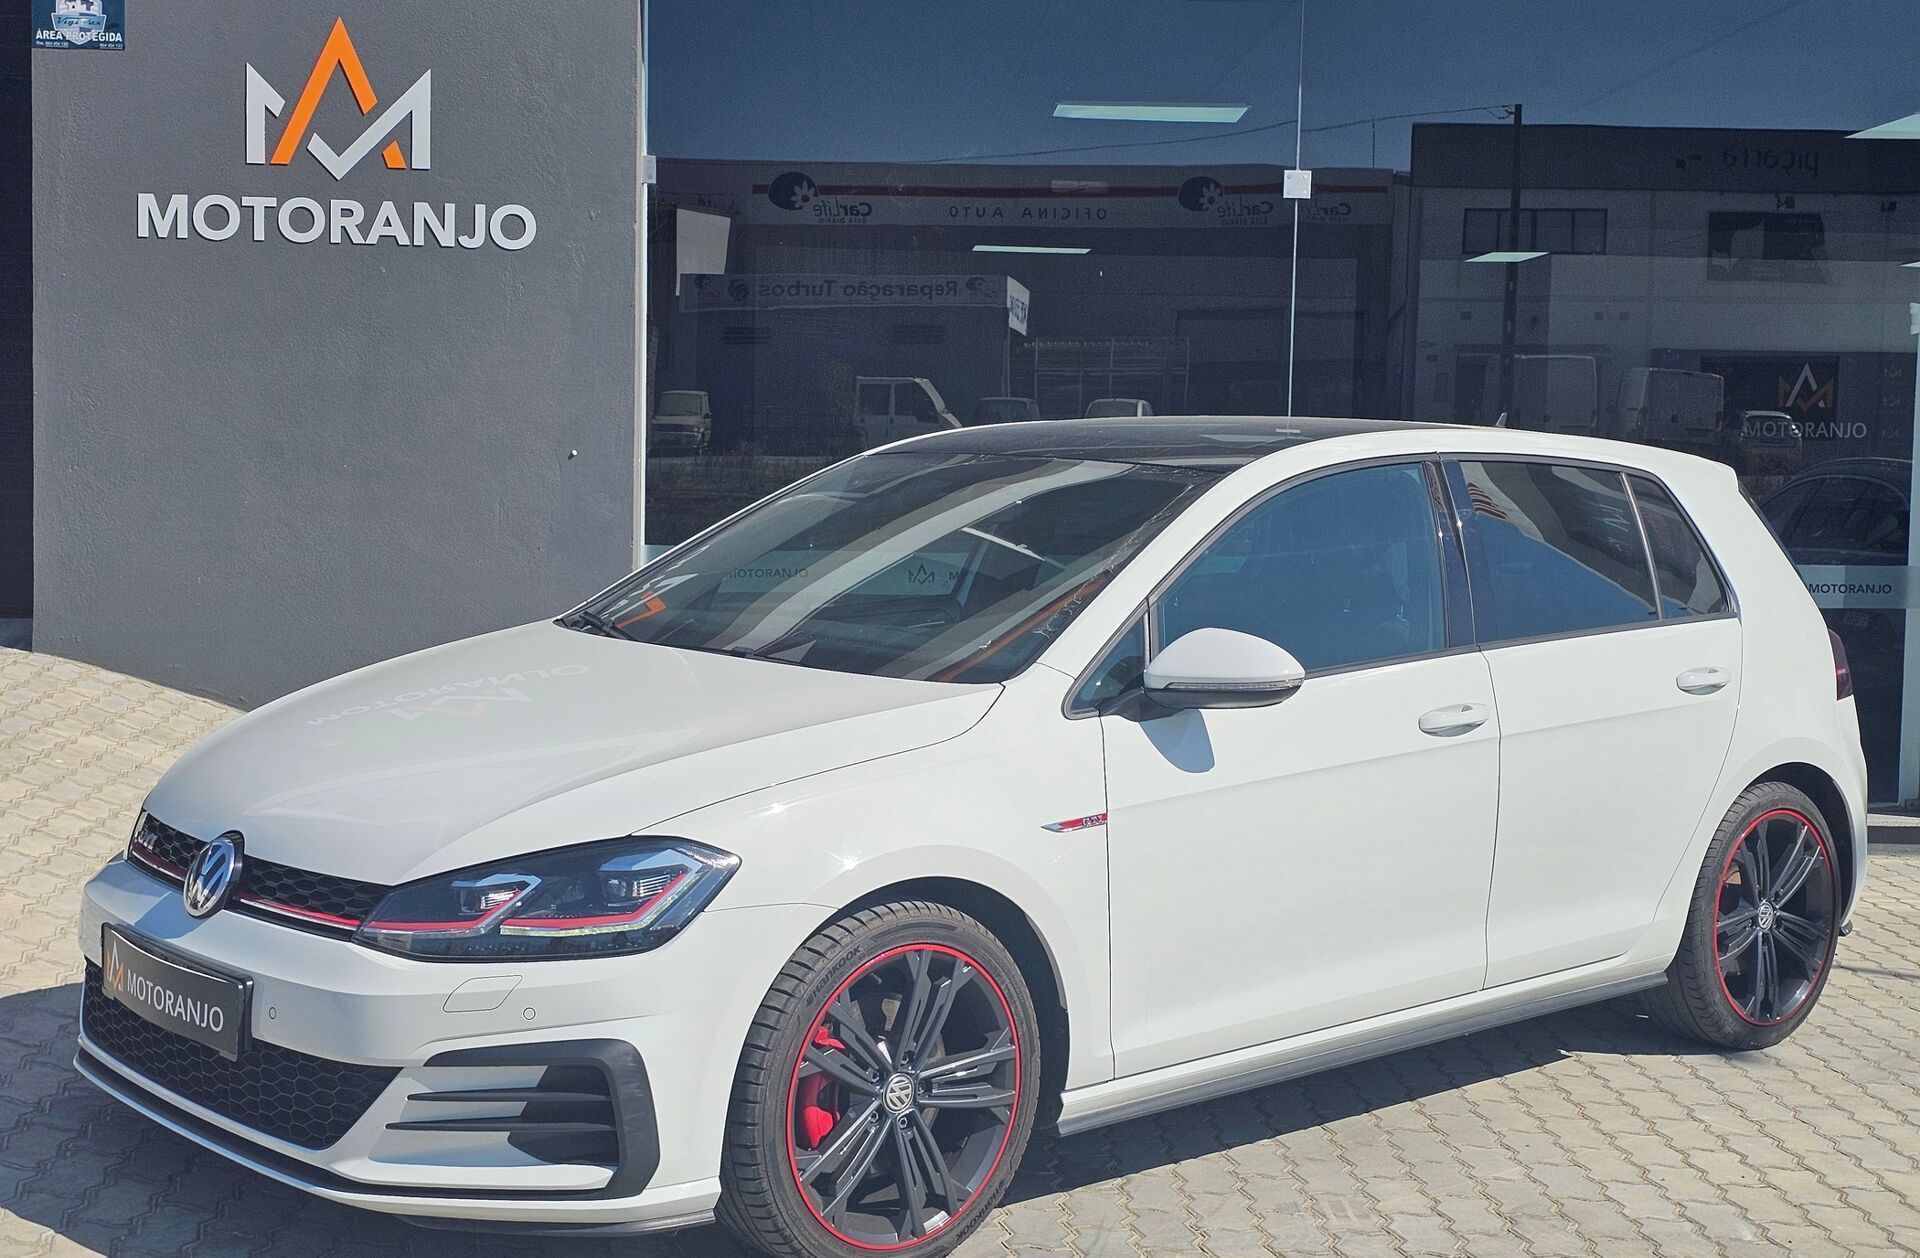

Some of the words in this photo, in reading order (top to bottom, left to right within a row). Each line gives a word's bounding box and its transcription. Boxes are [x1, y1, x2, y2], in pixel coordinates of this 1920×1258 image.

[36, 27, 63, 40] ÁREA
[65, 30, 123, 42] PROTEGIDA
[136, 192, 539, 250] MOTORANJO
[1745, 421, 1868, 440] MOTORANJO
[1808, 583, 1892, 594] MOTORANJO
[126, 968, 224, 1033] MOTORANJO
